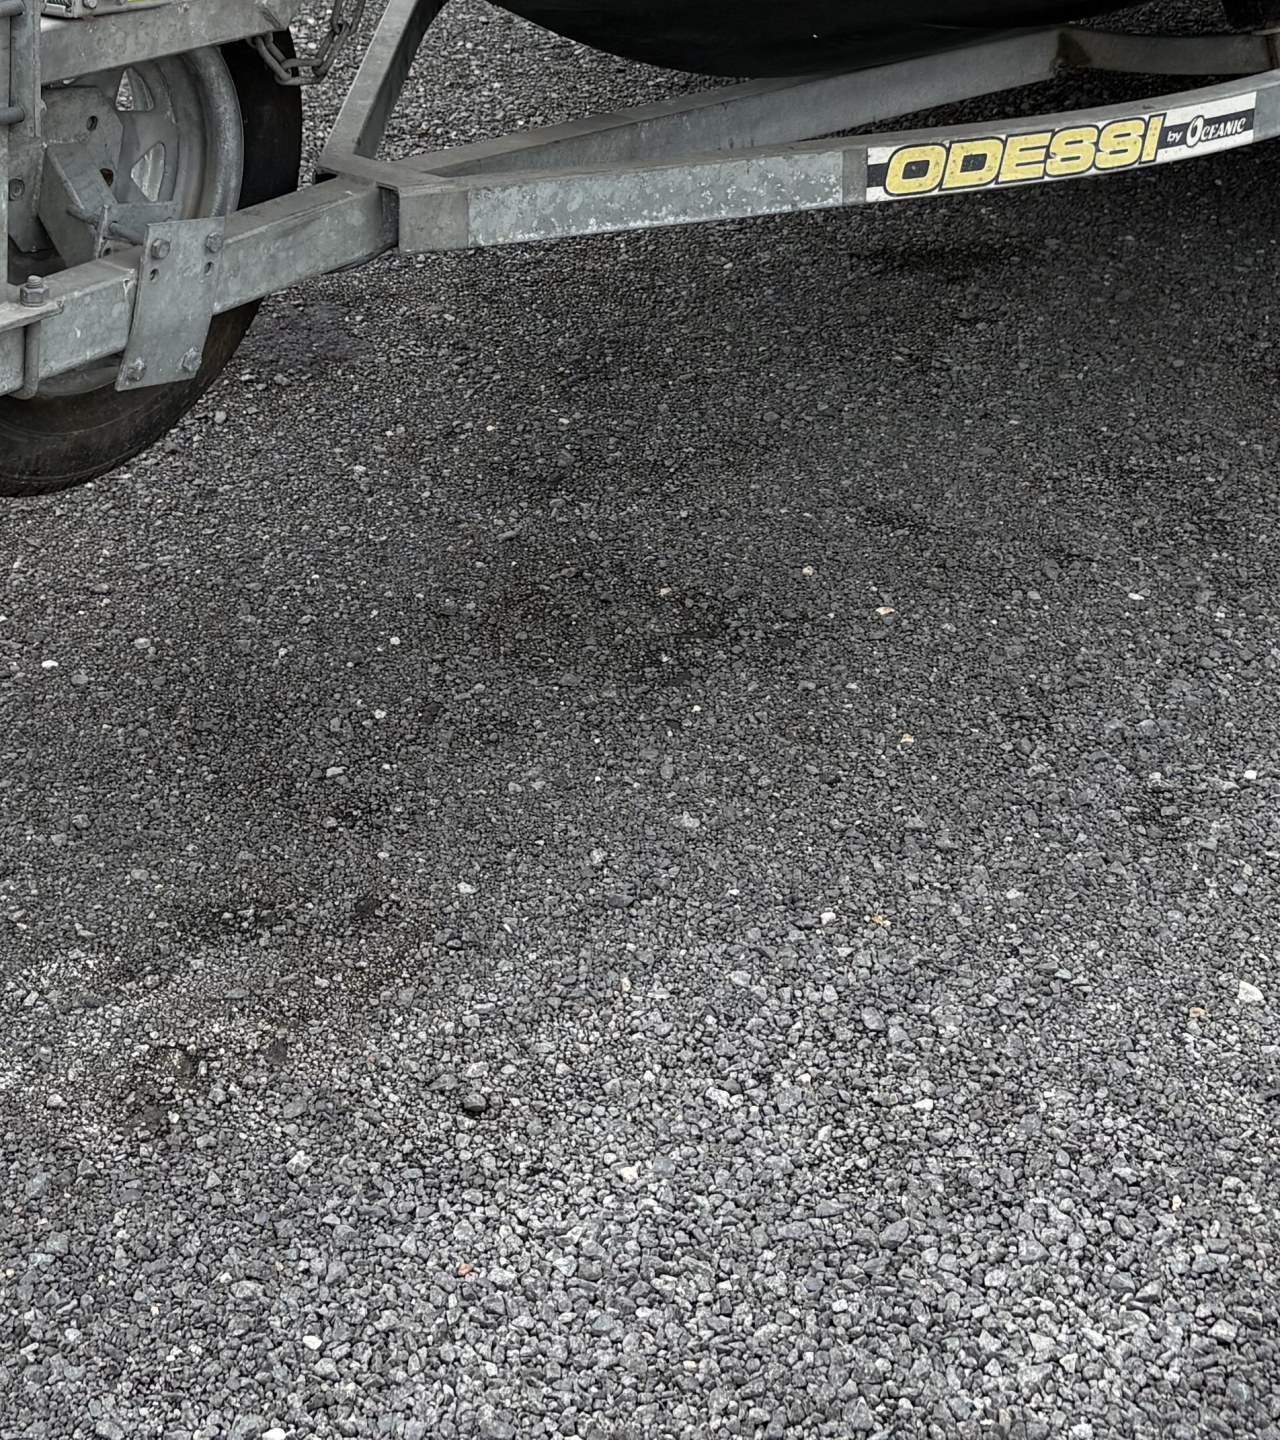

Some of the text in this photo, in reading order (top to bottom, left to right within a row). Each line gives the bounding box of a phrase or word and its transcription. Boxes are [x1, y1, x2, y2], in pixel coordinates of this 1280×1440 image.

[883, 112, 1246, 197] ODESSI by OCEANIC
